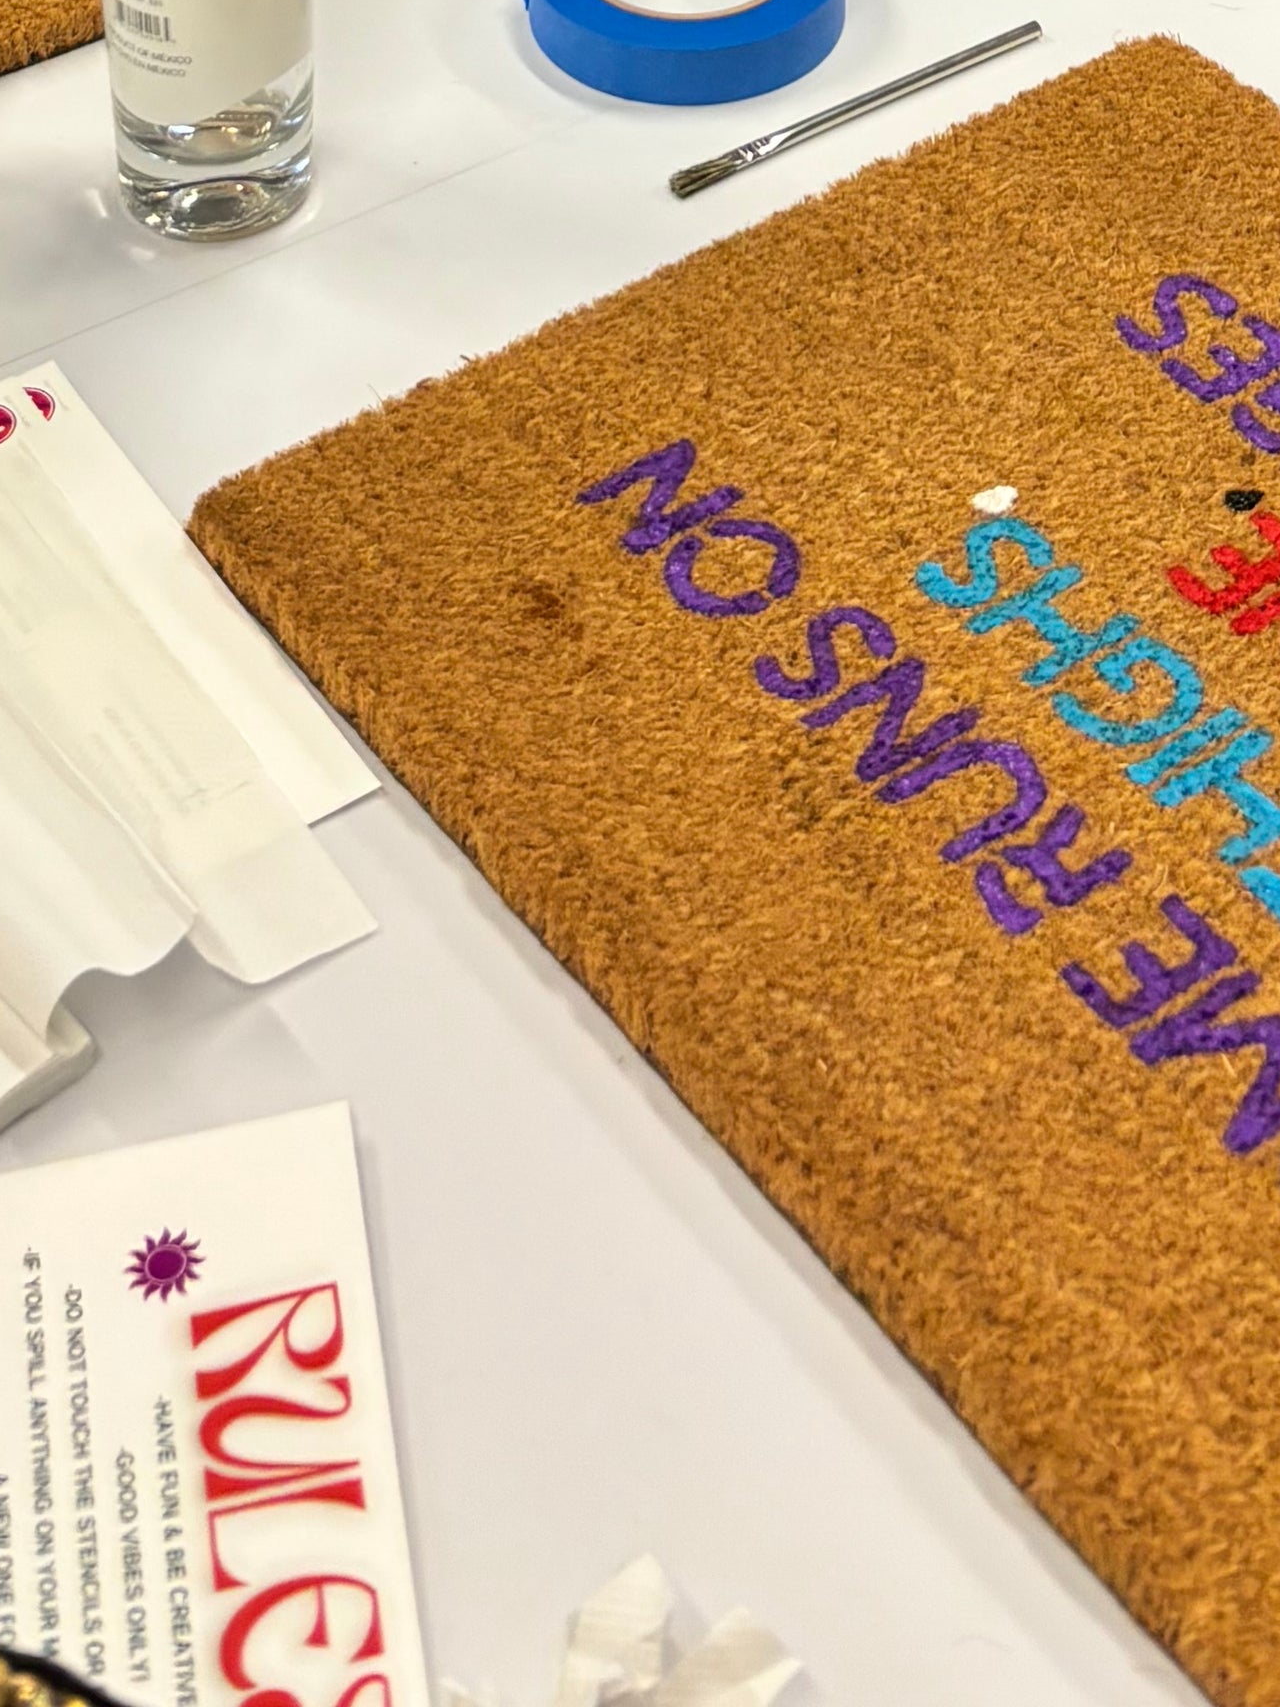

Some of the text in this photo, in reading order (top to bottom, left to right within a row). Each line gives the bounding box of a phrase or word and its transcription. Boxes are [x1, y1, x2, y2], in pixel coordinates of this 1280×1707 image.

[577, 437, 802, 619] ON
[753, 605, 1134, 937] RUNS
[23, 1275, 42, 1324] YOU
[25, 1327, 45, 1390] SPILL
[67, 1327, 86, 1372] NOT
[69, 1378, 90, 1459] TOUCH
[154, 1396, 176, 1463] -HAVE
[29, 1398, 52, 1514] ANYTHING
[74, 1464, 94, 1509] THE
[159, 1469, 179, 1519] FUN
[34, 1519, 54, 1555] ON
[115, 1447, 150, 1682] -GOOD VIBES ONLY!
[163, 1525, 183, 1542] &
[165, 1548, 186, 1581] BE
[37, 1560, 59, 1631] YOUR
[76, 1516, 102, 1634] STENCILS
[84, 1639, 104, 1678] OR
